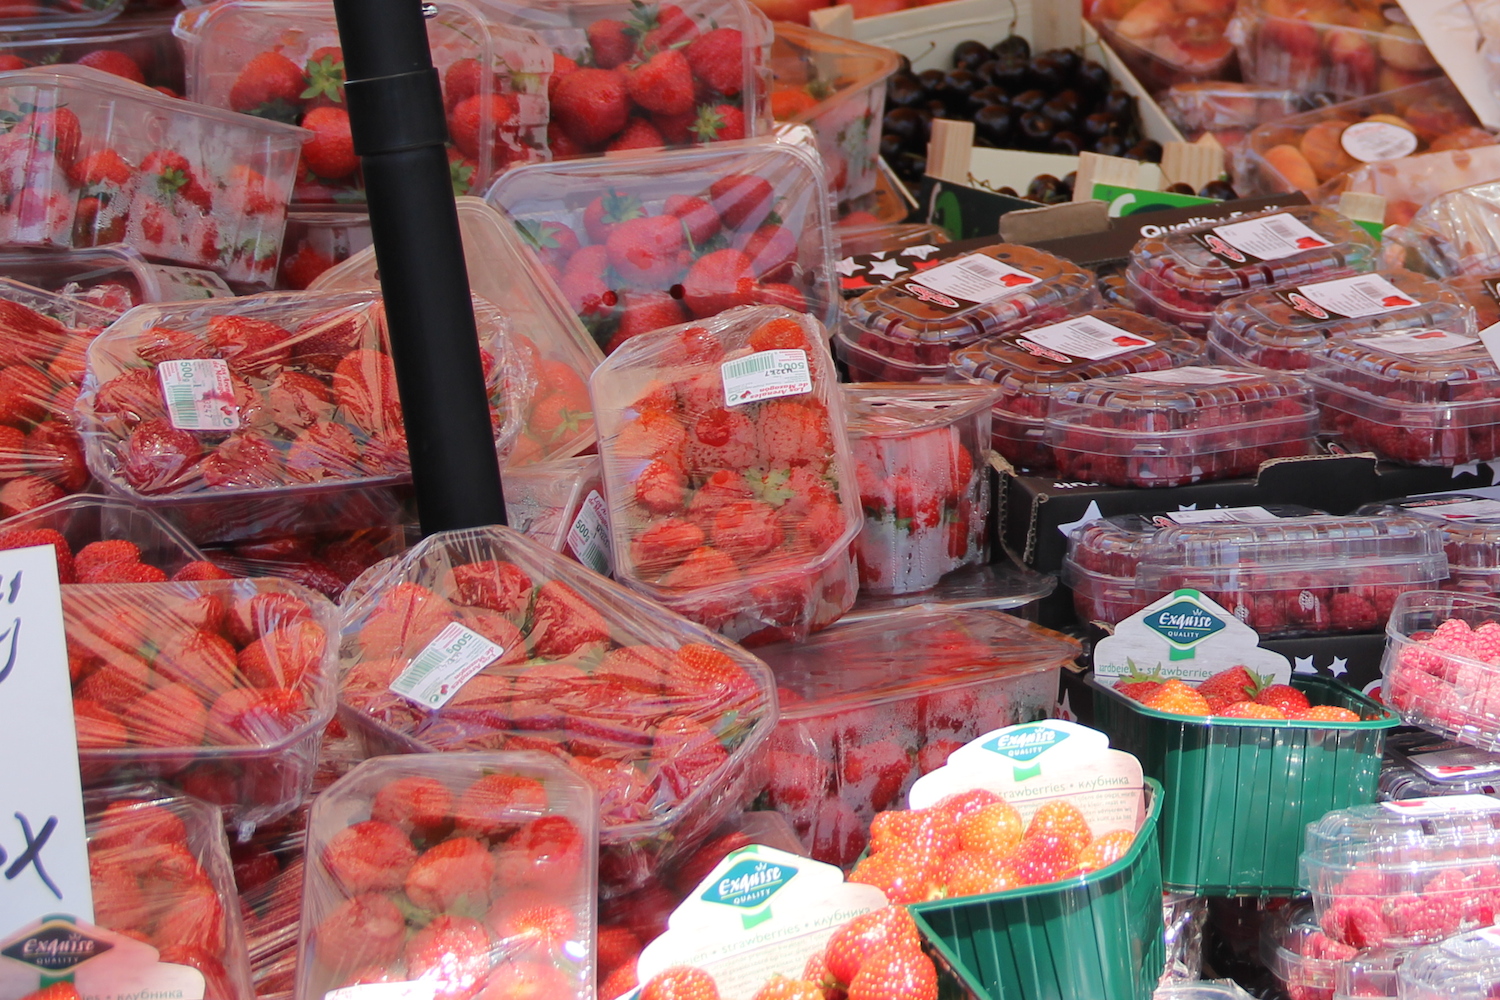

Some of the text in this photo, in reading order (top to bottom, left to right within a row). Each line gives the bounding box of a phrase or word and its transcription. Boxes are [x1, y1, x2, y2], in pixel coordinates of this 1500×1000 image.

[1158, 611, 1213, 630] Exquise
[1167, 630, 1200, 639] QUALITY
[1098, 661, 1132, 674] aardbeie
[996, 728, 1056, 751] Exquise
[1007, 745, 1043, 758] QUALITY
[996, 782, 1067, 800] trawberries
[1077, 774, 1131, 794] клубника
[717, 864, 782, 897] Exquise
[732, 886, 772, 905] QUALITY
[22, 937, 96, 958] Exquise
[35, 956, 80, 965] QUALITY
